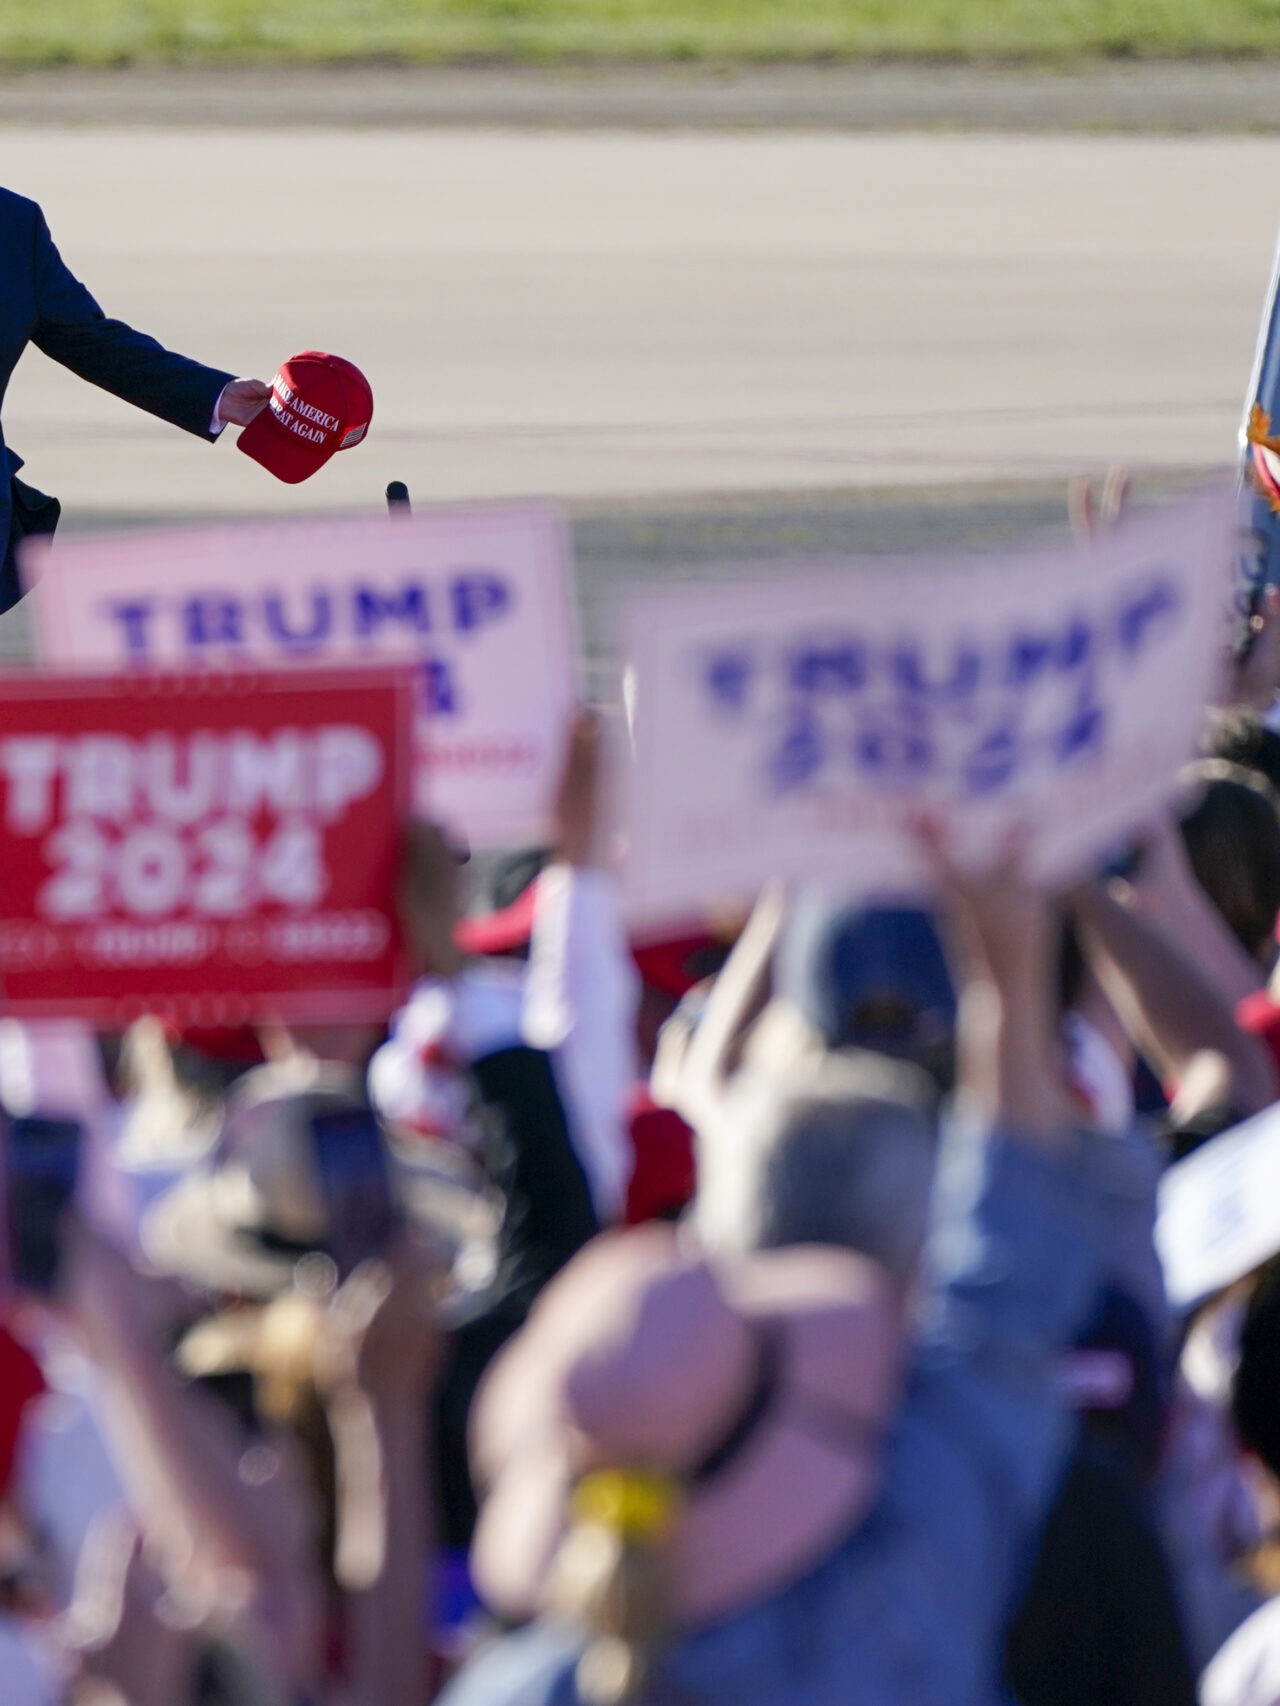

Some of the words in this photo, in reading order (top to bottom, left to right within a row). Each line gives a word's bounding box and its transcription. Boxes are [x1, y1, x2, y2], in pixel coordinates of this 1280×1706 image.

[290, 397, 340, 432] AMERICA
[290, 420, 328, 444] AGAIN
[102, 570, 517, 662] TRUMP
[37, 812, 327, 918] 2024
